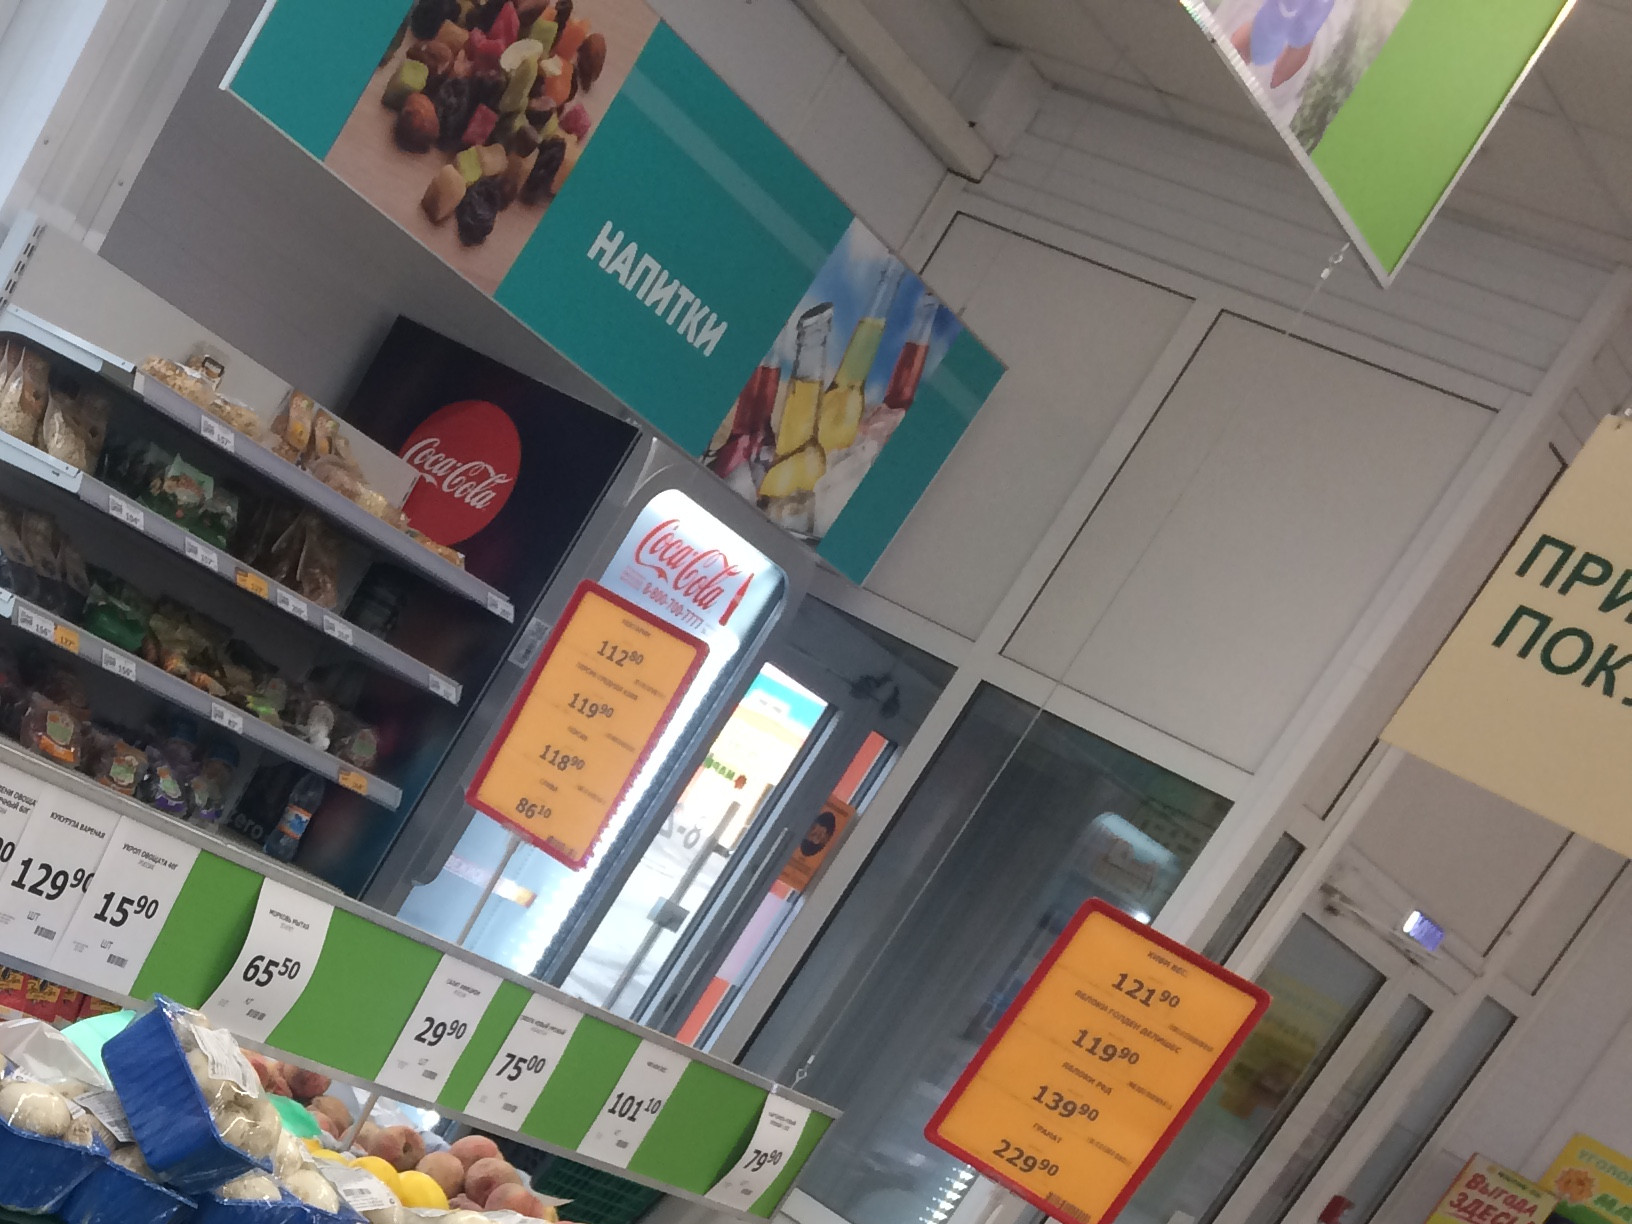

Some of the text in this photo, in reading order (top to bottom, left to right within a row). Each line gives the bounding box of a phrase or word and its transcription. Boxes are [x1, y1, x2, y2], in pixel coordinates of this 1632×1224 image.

[587, 220, 728, 357] НАПИТКИ
[400, 437, 512, 511] Coca-Cola
[634, 519, 743, 611] Coca-Cola
[1491, 604, 1632, 707] ПОК
